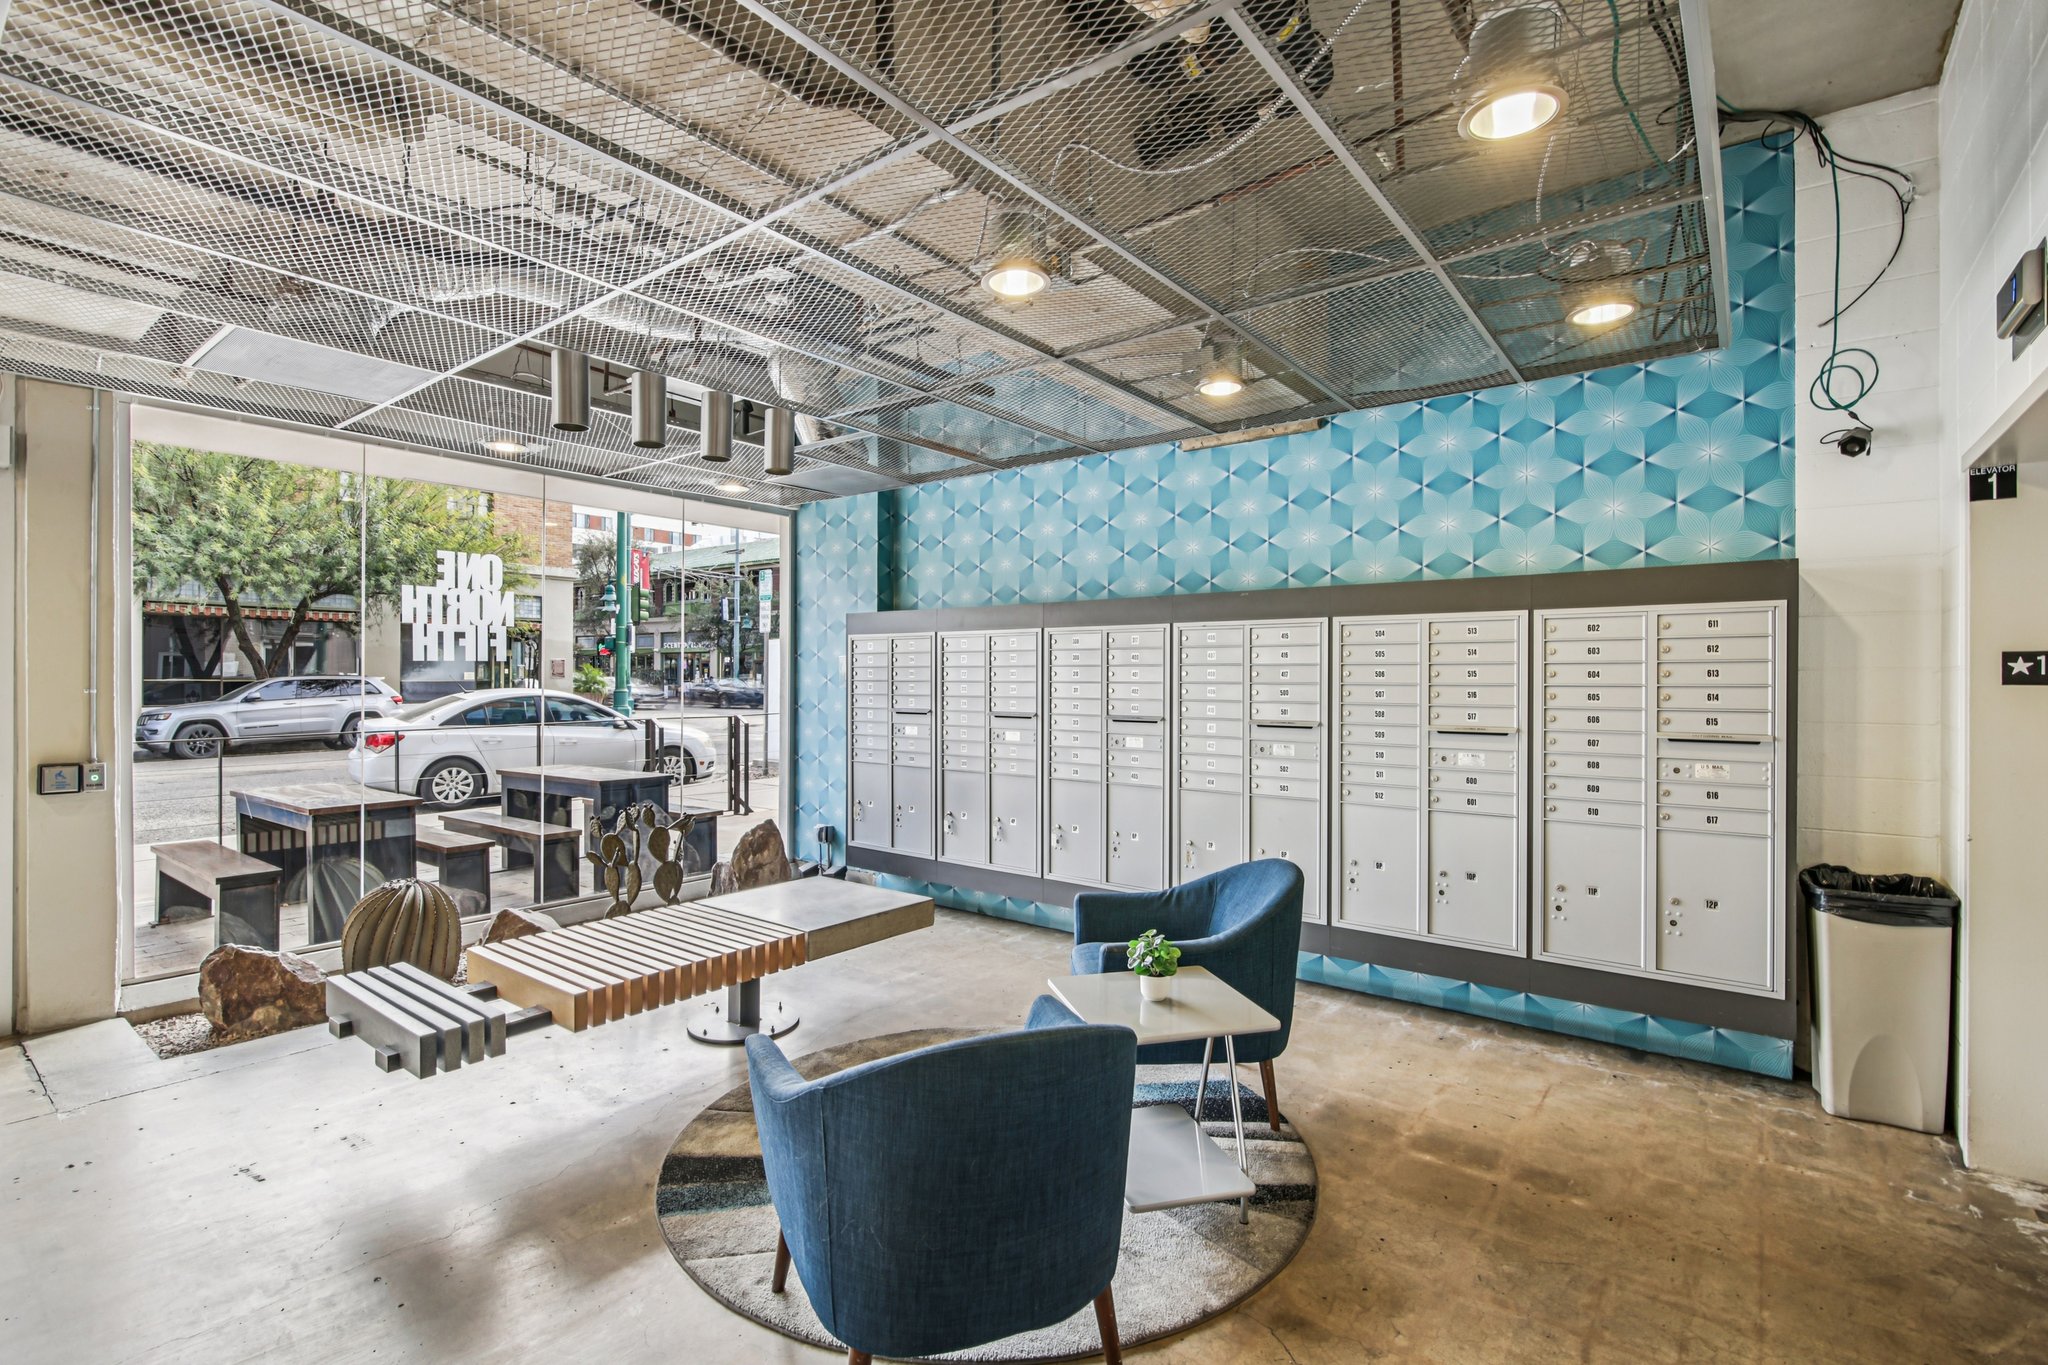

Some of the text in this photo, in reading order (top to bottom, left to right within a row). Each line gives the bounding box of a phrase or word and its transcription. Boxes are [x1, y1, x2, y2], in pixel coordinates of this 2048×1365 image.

[1970, 464, 2016, 476] ELEVATOR
[1987, 473, 1998, 500] 1
[1587, 623, 1601, 633] 602
[1707, 619, 1719, 628] 611
[1375, 630, 1385, 638] 504
[1467, 627, 1478, 635] 513
[1280, 632, 1289, 640] 415
[1467, 648, 1477, 656] 514
[1587, 646, 1601, 655] 603
[1706, 644, 1720, 653] 612
[1280, 651, 1289, 659] 416
[1374, 650, 1386, 658] 505
[2036, 655, 2046, 676] 1
[1374, 670, 1385, 678] 506
[1467, 670, 1478, 678] 515
[1587, 670, 1600, 679] 604
[1706, 669, 1720, 678] 613
[1279, 689, 1289, 697] 500
[1374, 690, 1385, 698] 507
[1467, 691, 1478, 699] 516
[1587, 693, 1601, 702] 605
[1706, 693, 1719, 702] 614
[1280, 708, 1289, 716] 501
[1374, 710, 1385, 718] 508
[1467, 712, 1477, 721] 517
[1587, 715, 1600, 724] 606
[1705, 717, 1719, 727] 615
[1374, 731, 1385, 739] 509
[1587, 738, 1600, 747] 607
[1375, 751, 1385, 759] 510
[1279, 765, 1289, 773] 502
[1586, 760, 1600, 770] 608
[1375, 770, 1384, 778] 511
[1465, 776, 1478, 785] 600
[1279, 784, 1289, 792] 503
[1586, 784, 1600, 793] 609
[1374, 791, 1384, 800] 512
[1706, 790, 1719, 800] 616
[1466, 798, 1477, 806] 601
[1587, 807, 1599, 817] 610
[1706, 815, 1719, 825] 617
[1375, 861, 1383, 870] 9P
[1466, 872, 1477, 881] 10P
[1587, 887, 1598, 896] 11P
[1705, 899, 1719, 910] 12P
